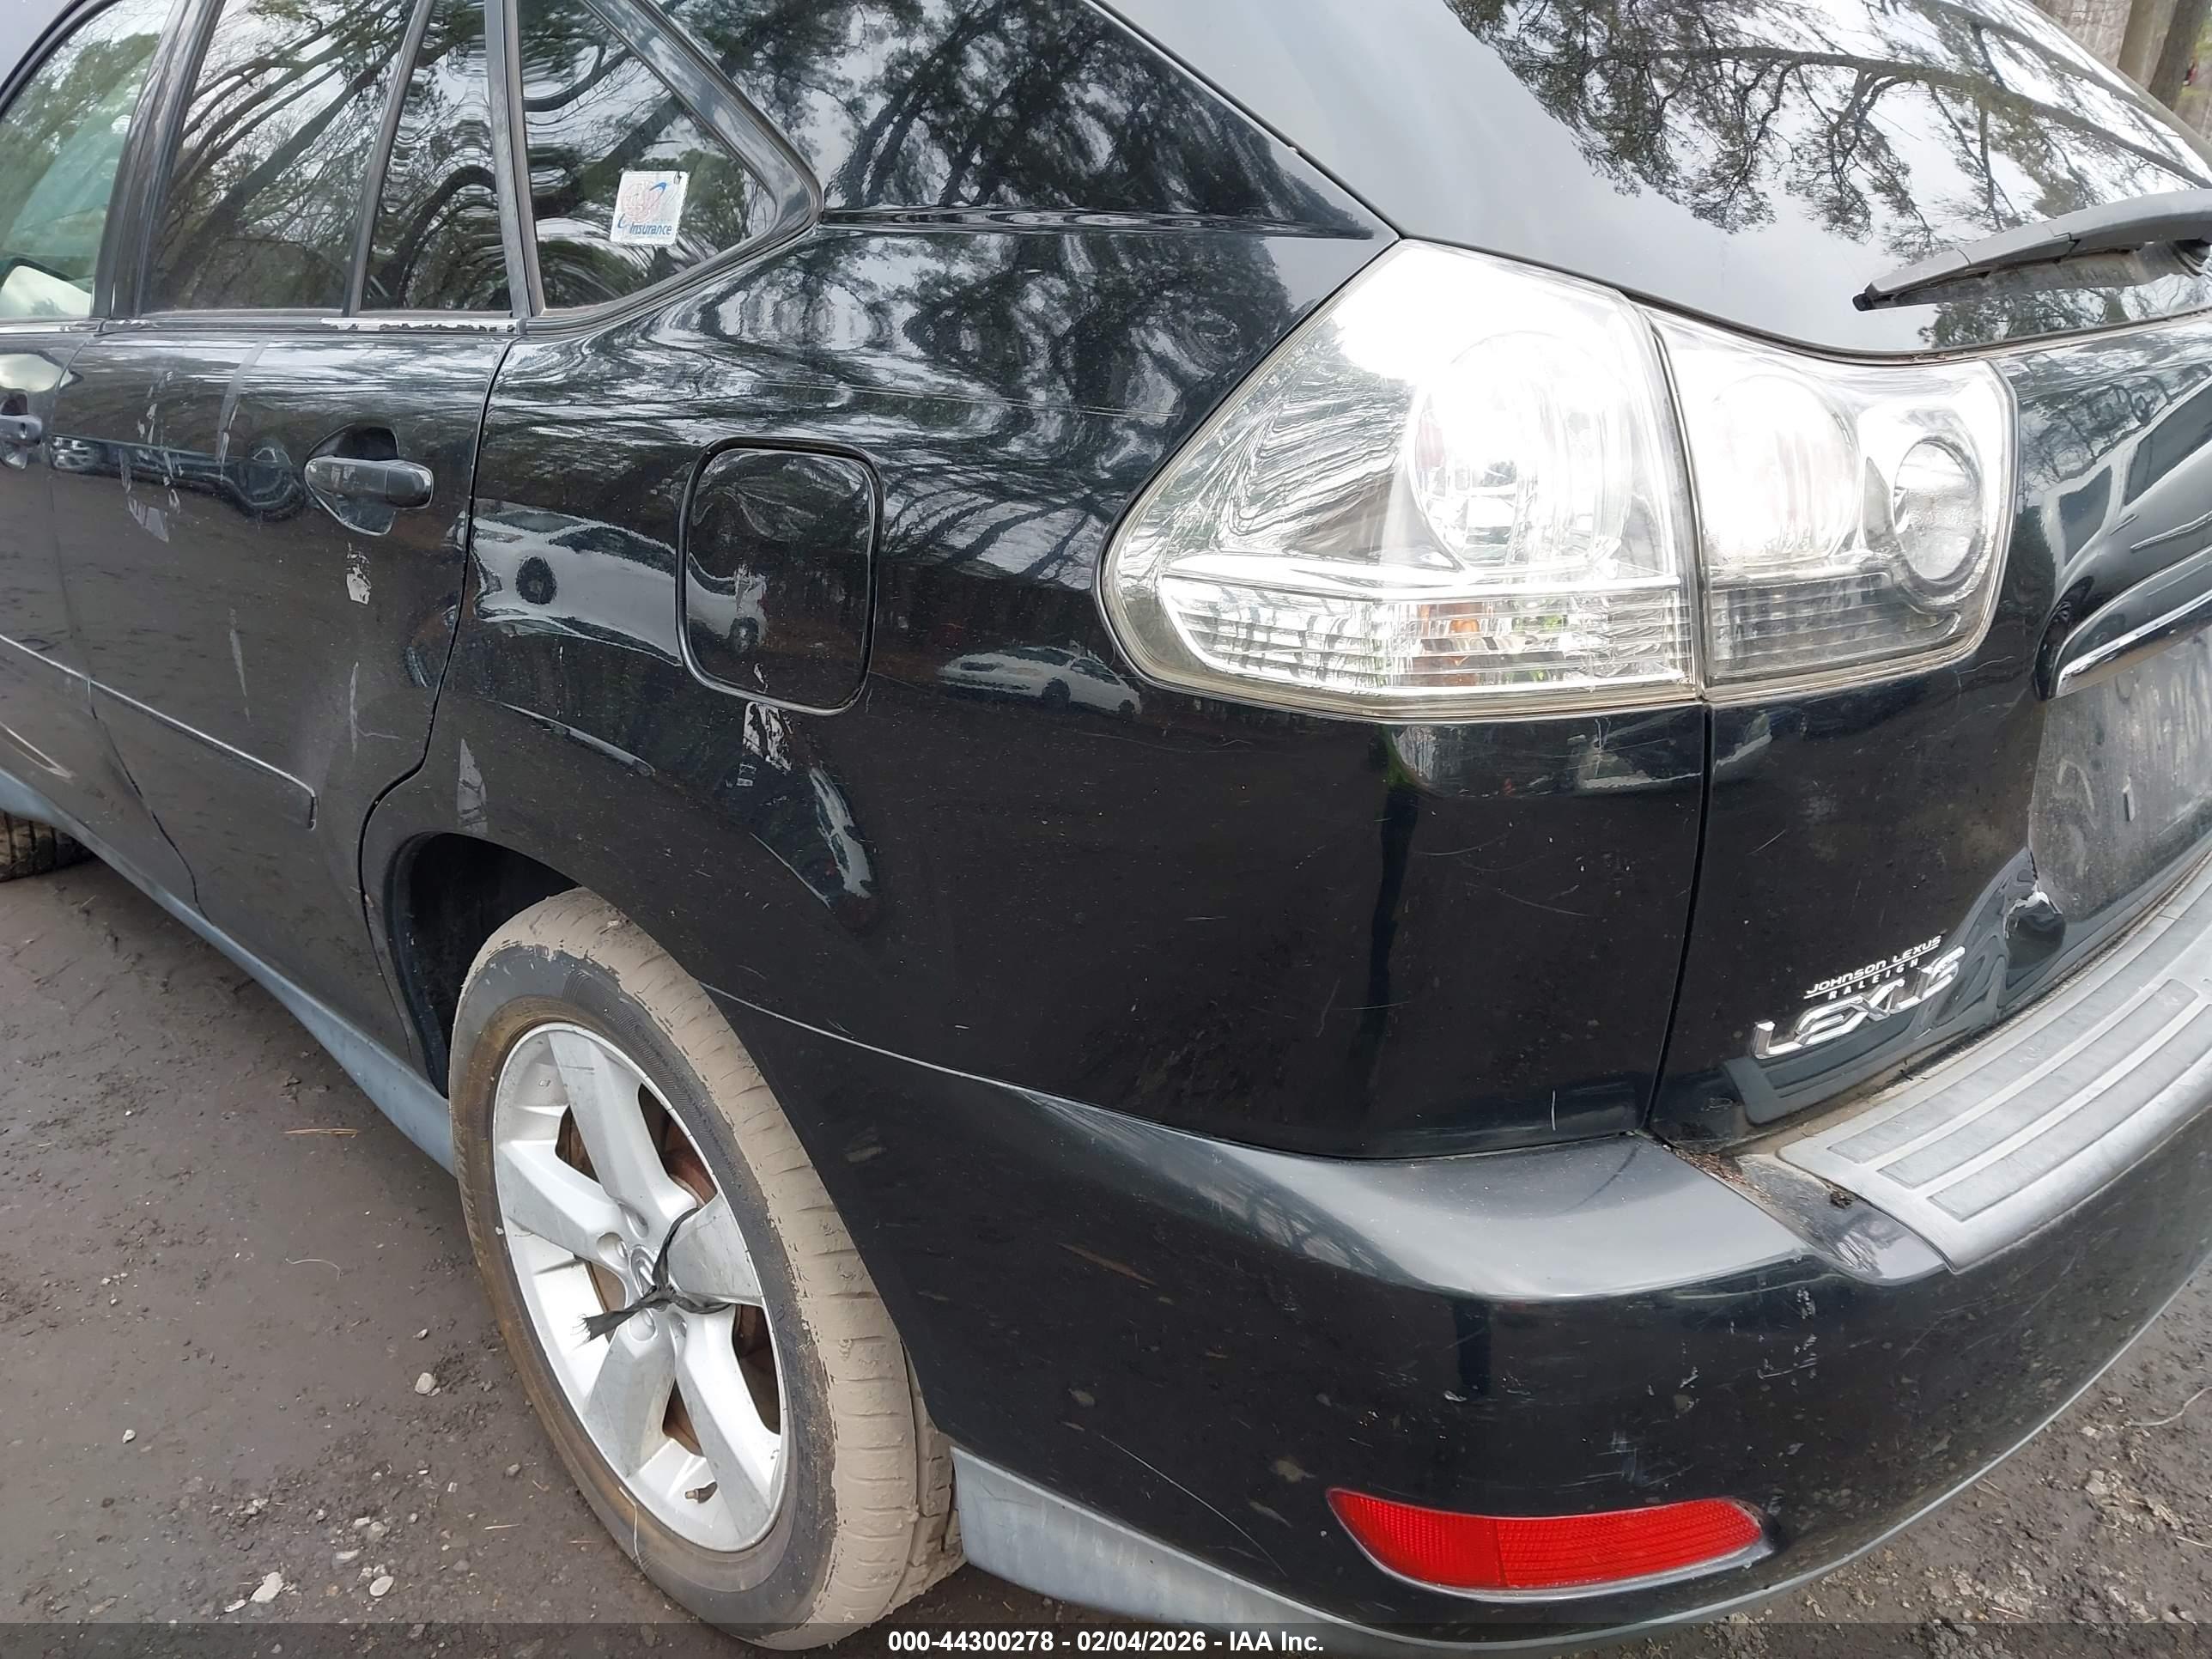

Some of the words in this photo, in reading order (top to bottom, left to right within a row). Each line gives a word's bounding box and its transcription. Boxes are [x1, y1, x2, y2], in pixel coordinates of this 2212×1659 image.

[629, 222, 672, 235] Insurance
[1893, 935, 1942, 963] LEXUS
[1827, 957, 1919, 1000] RALEIGH
[1752, 945, 1966, 1060] LEXUS
